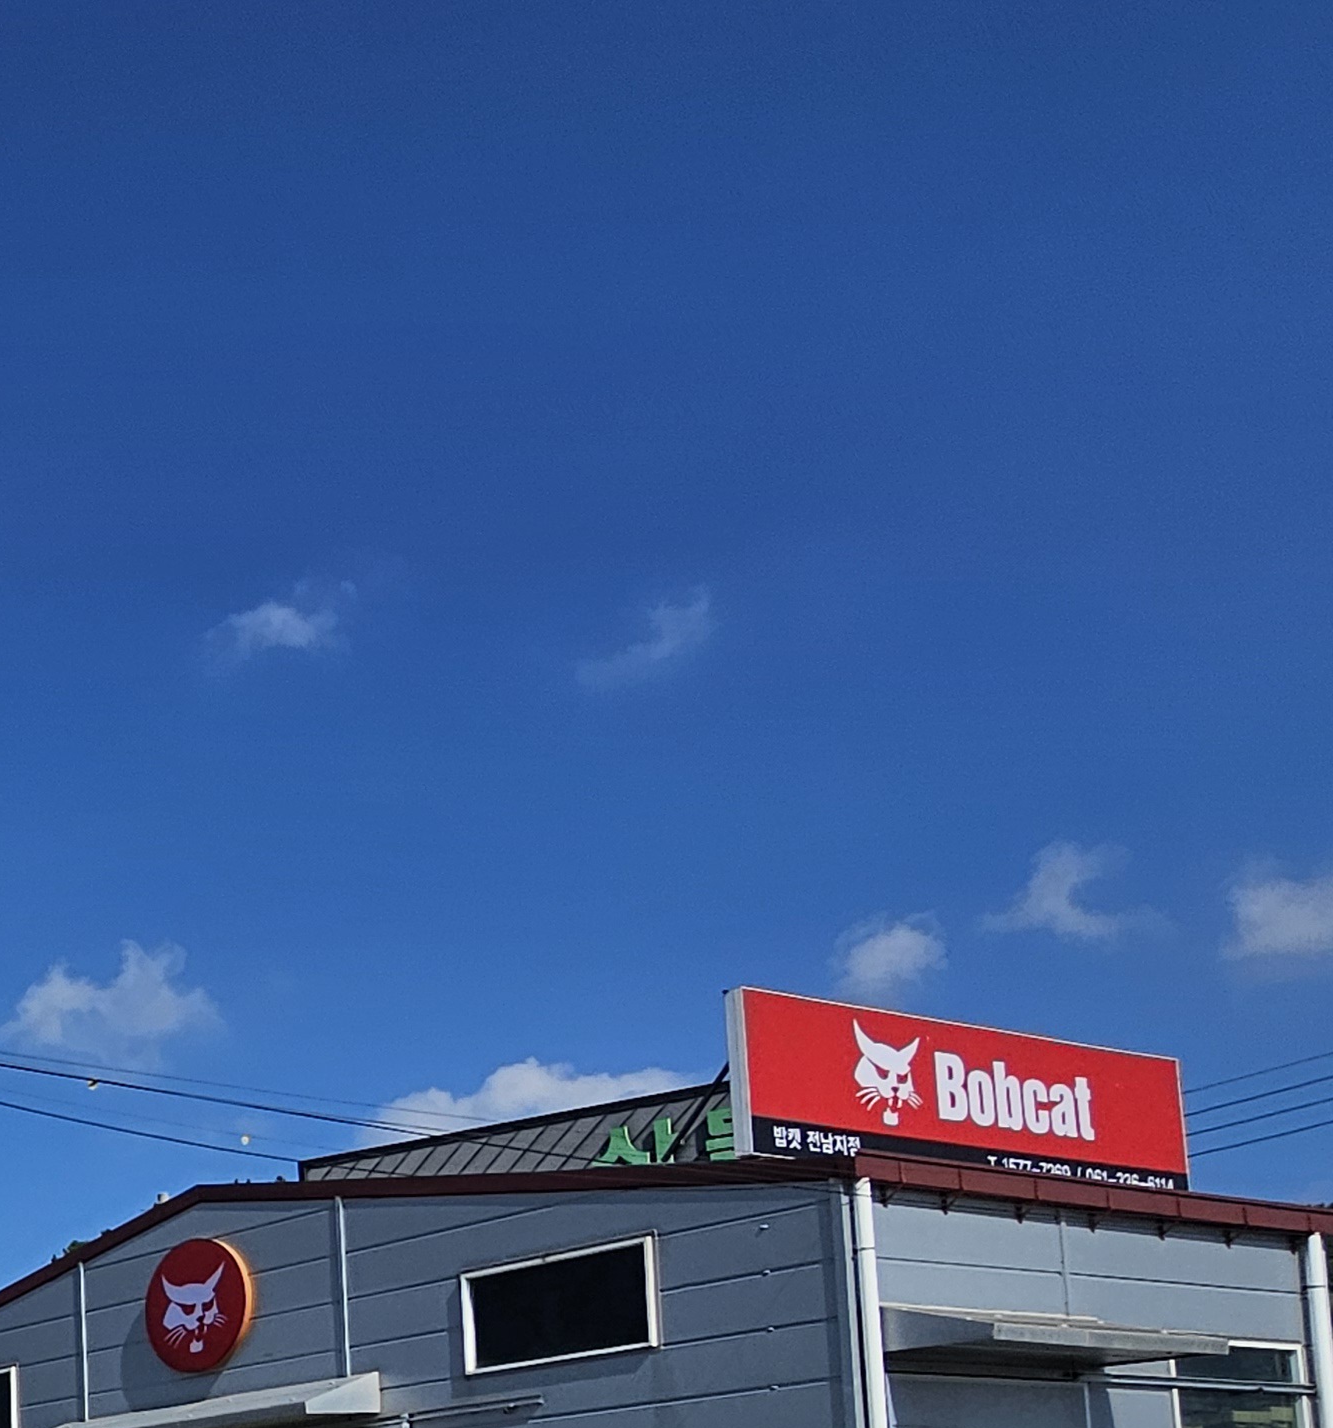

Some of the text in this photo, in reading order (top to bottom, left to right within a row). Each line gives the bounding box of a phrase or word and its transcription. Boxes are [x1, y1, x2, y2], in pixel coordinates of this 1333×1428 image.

[933, 1051, 1095, 1141] Bobcat
[773, 1126, 861, 1157] 밥캣 전남지점
